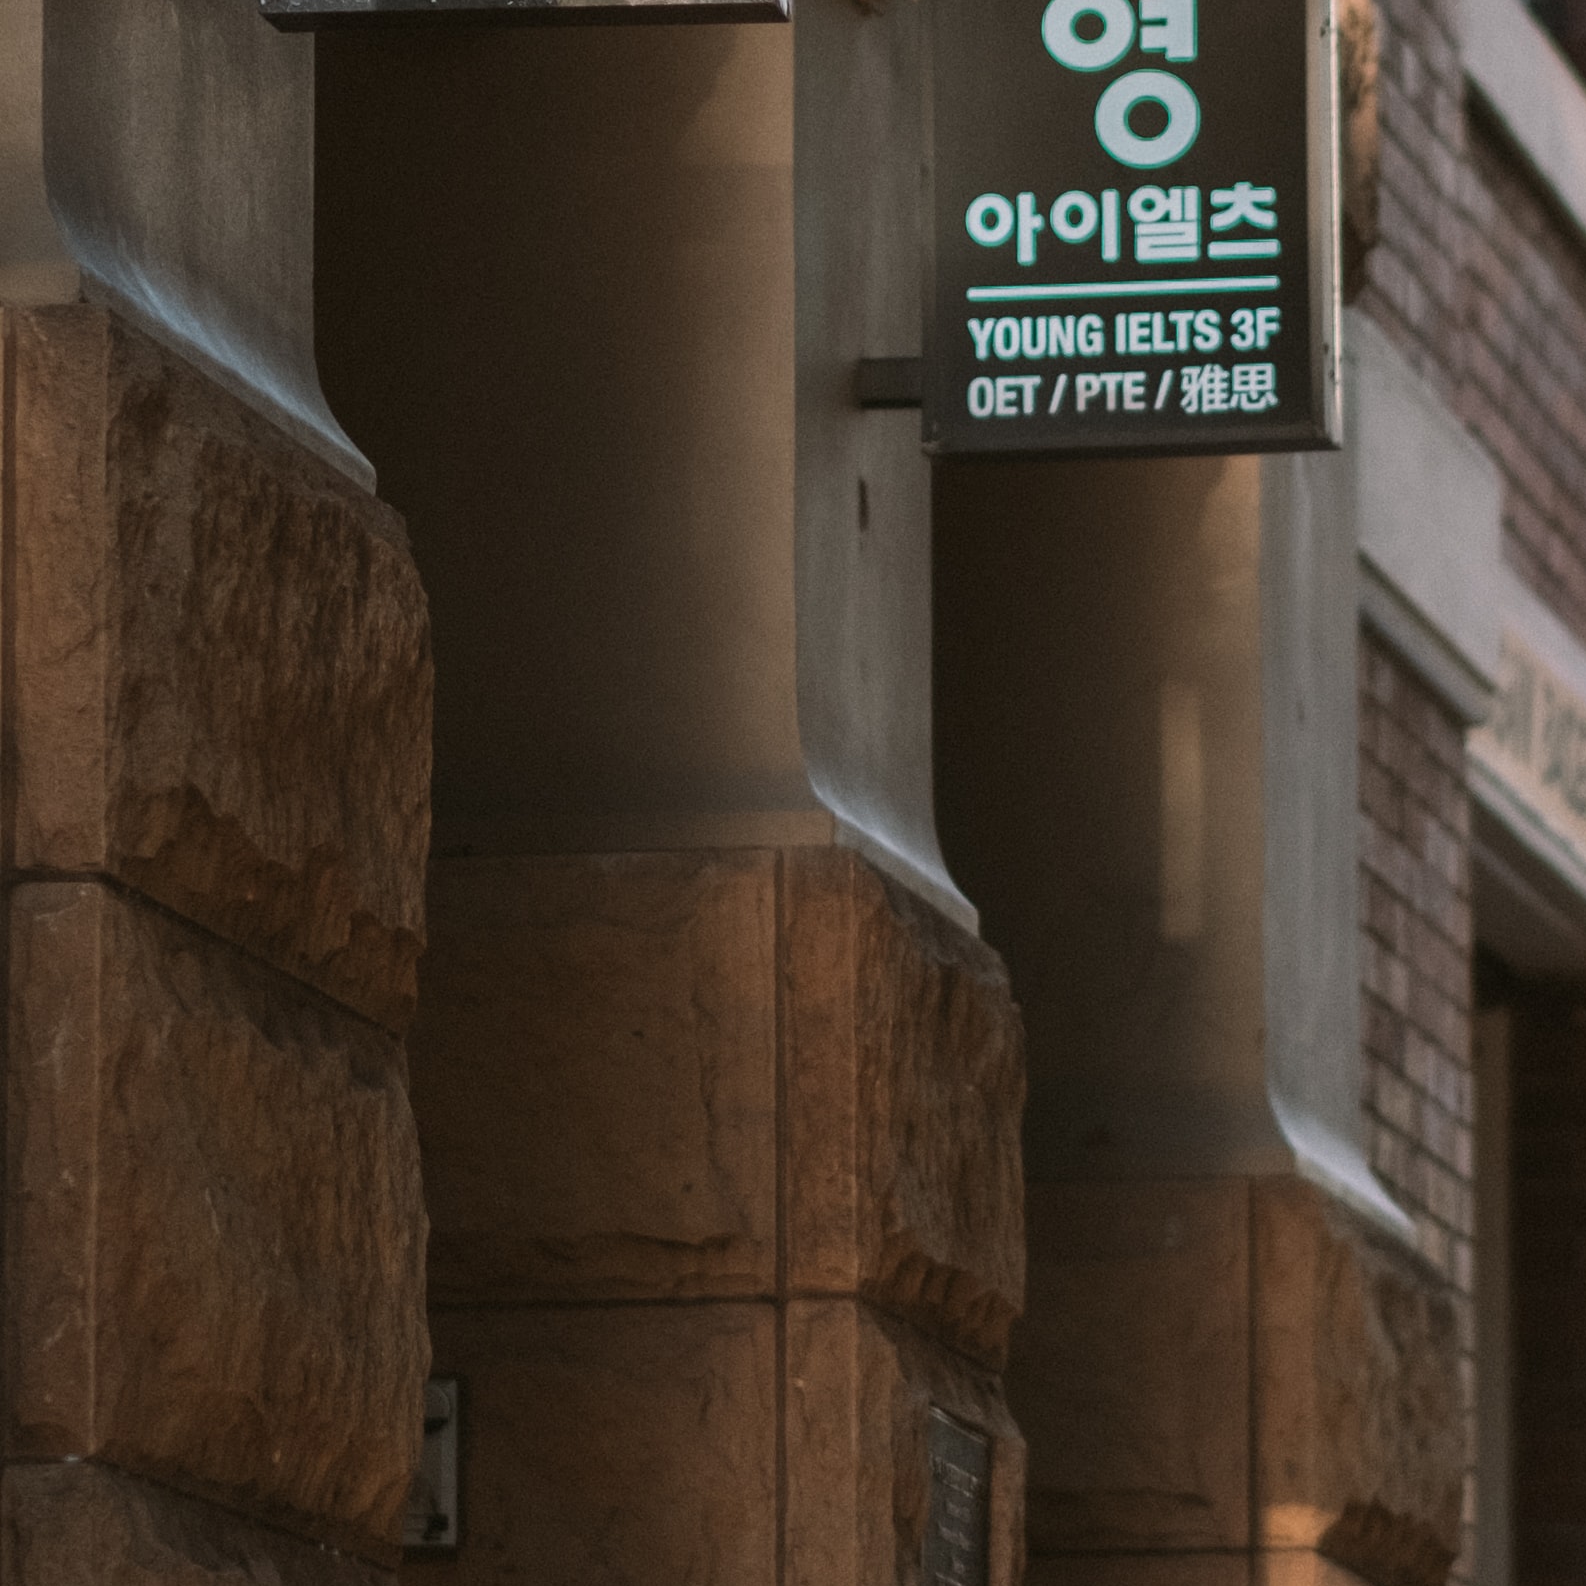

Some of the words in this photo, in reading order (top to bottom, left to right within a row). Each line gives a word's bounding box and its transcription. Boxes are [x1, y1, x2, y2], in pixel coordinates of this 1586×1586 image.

[965, 181, 1281, 266] 아이엘츠
[967, 314, 1104, 360] YOUNG
[1115, 309, 1222, 354] IELTS
[1230, 306, 1281, 351] 3F
[967, 375, 1042, 418] OET
[1075, 371, 1147, 412] PTE
[1180, 362, 1279, 414] 雅思
